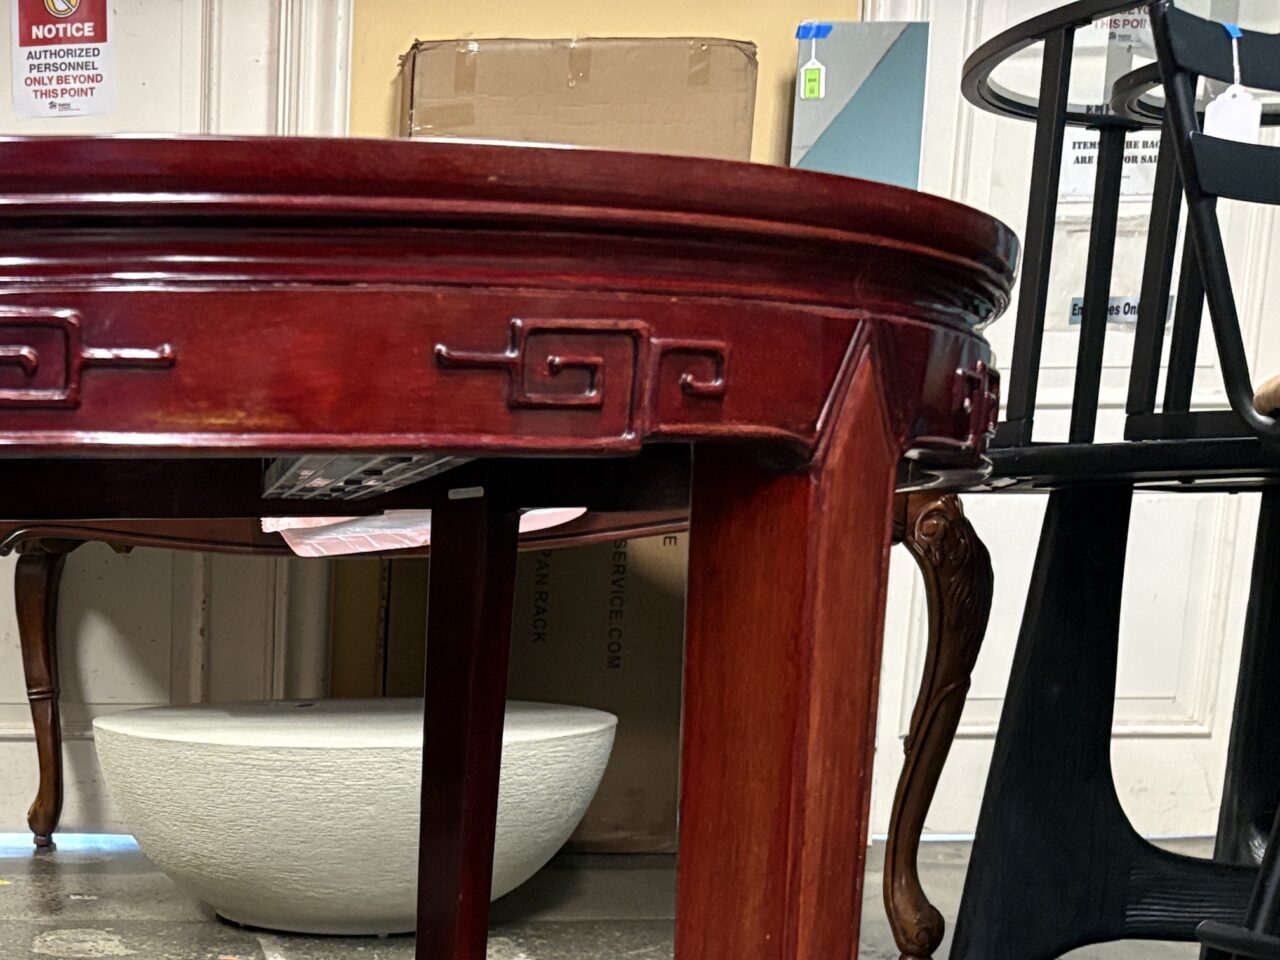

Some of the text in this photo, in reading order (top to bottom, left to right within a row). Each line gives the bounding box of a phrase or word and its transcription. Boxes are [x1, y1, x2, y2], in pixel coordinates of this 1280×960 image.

[31, 22, 95, 39] NOTICE
[26, 47, 100, 60] AUTHORIZED
[29, 61, 98, 73] PERSONNEL
[24, 73, 103, 87] ONLY BEYOND
[32, 87, 95, 99] THIS POINT
[1073, 156, 1094, 164] ARE
[1123, 155, 1138, 164] OR
[532, 591, 548, 644] RACK
